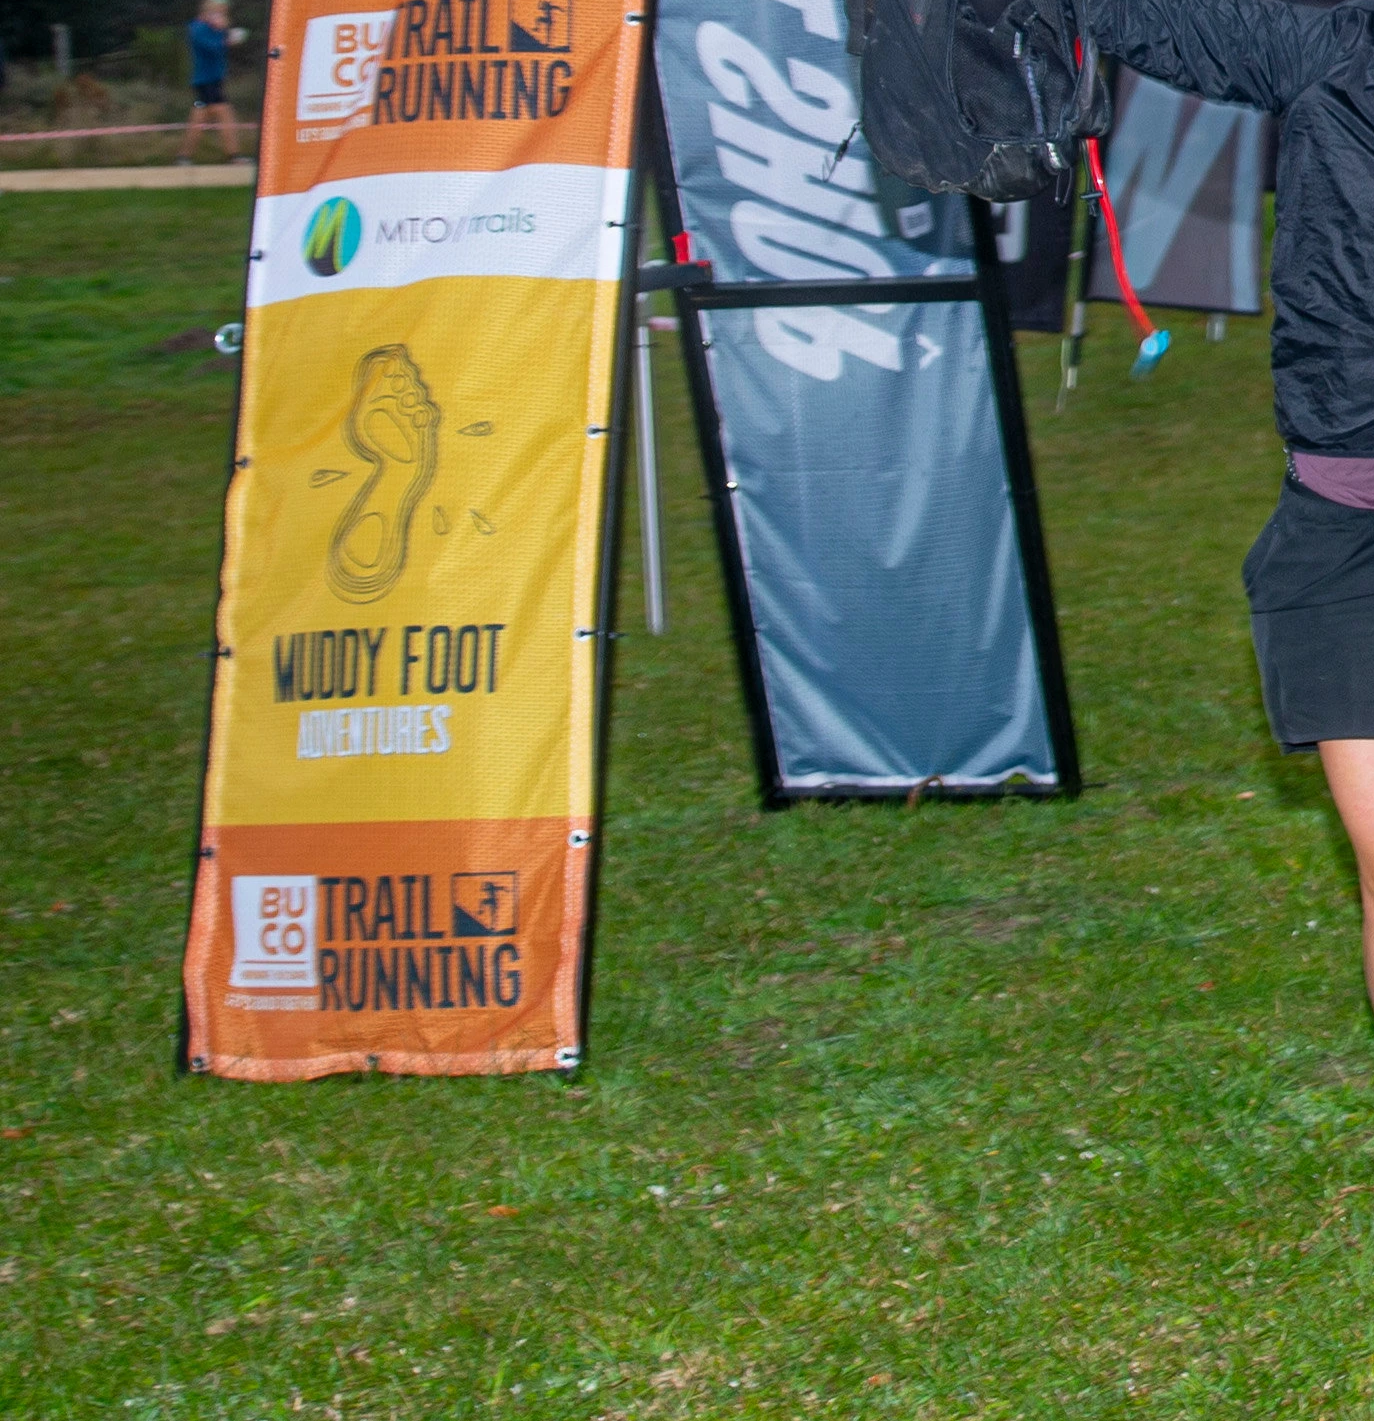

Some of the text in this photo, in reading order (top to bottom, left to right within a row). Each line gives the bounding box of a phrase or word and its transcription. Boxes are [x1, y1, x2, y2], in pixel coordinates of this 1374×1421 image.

[371, 60, 573, 125] RUNNING
[375, 216, 449, 244] MTO
[272, 623, 507, 703] MUDDY FOOT
[296, 704, 452, 761] ADVENTURES
[261, 886, 307, 920] BU
[319, 874, 444, 941] TRAIL
[260, 922, 307, 955] CO
[318, 943, 521, 1012] RUNNING
